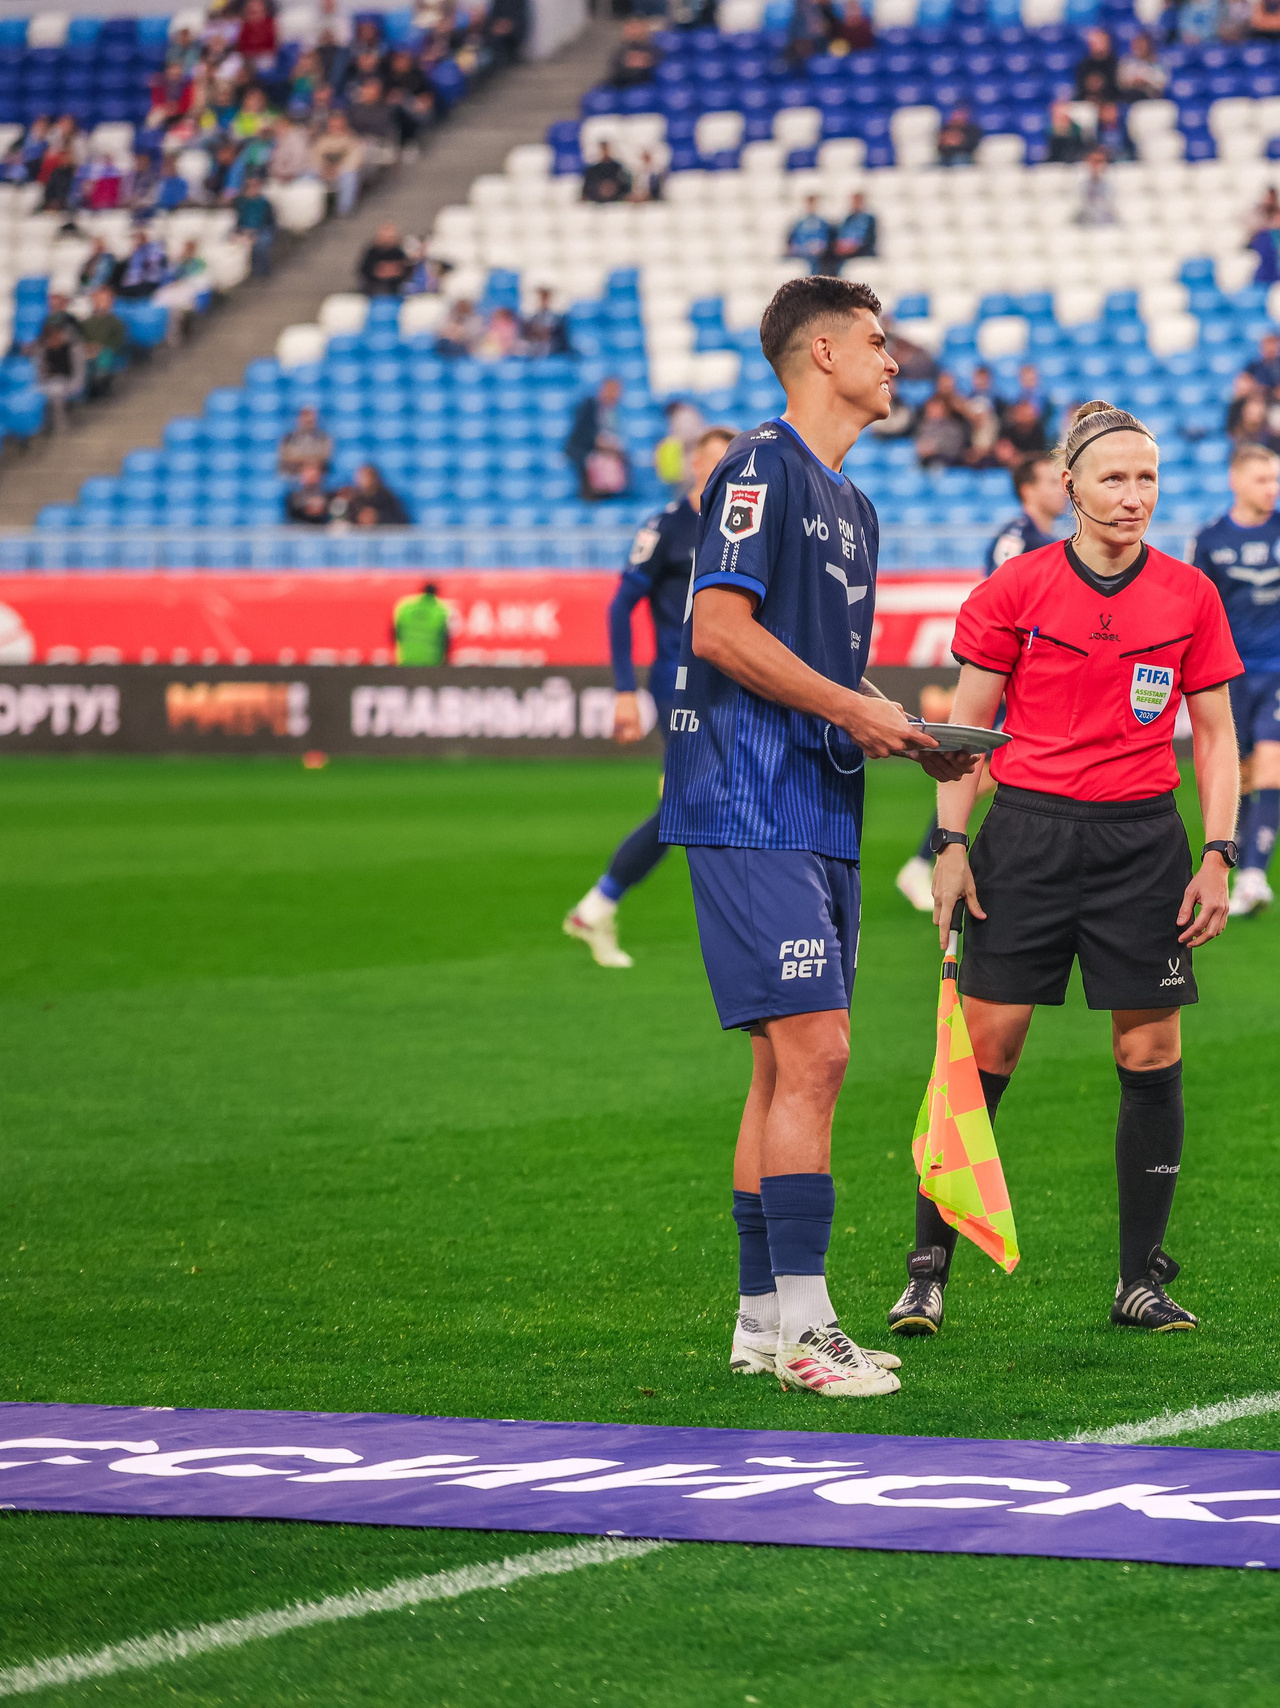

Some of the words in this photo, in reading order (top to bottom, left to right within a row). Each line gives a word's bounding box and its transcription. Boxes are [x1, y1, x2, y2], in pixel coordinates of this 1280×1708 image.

[838, 518, 854, 541] FON
[1137, 667, 1170, 686] FIFA
[1135, 688, 1167, 698] ASSISTANT
[1136, 696, 1163, 705] REFEREE
[670, 708, 700, 732] СТЬ
[1139, 711, 1154, 720] 2026
[778, 938, 825, 960] FON
[781, 958, 827, 980] BET
